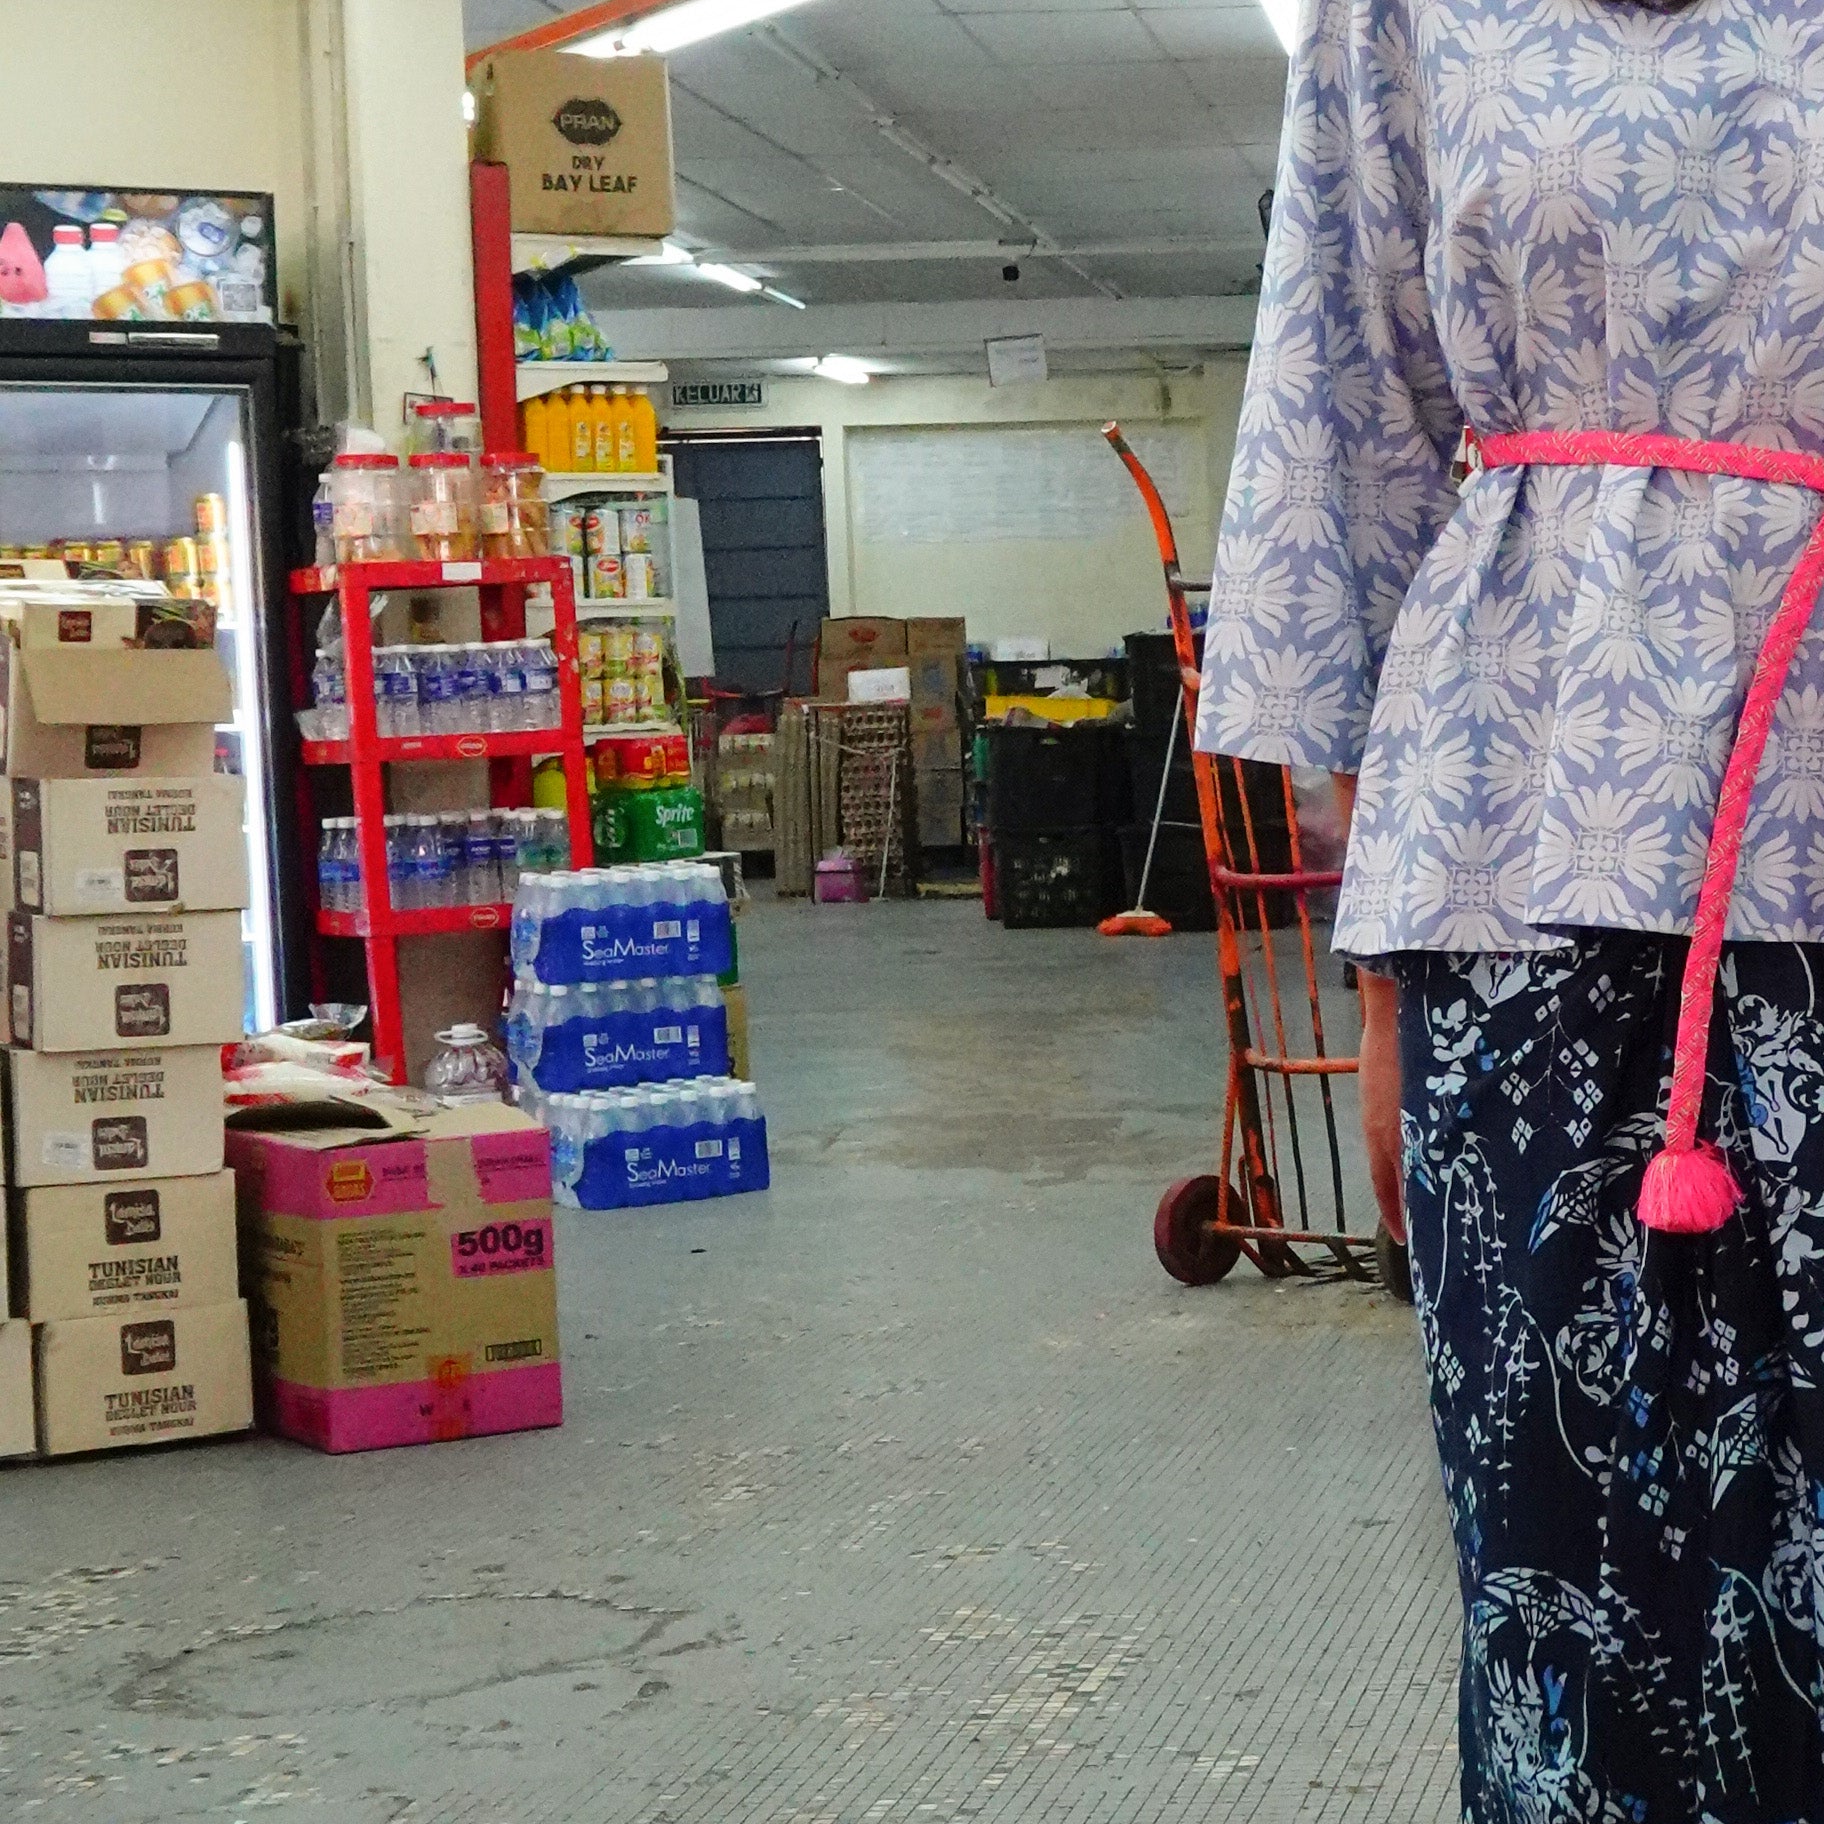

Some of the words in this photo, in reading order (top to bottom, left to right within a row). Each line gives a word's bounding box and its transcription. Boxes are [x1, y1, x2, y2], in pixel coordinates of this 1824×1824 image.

[572, 155, 605, 171] DRY
[542, 173, 582, 191] BAY
[589, 174, 637, 193] LEAF
[675, 383, 745, 404] KELUAR
[108, 815, 196, 834] TUNISIAN
[656, 804, 694, 827] Sprite
[582, 938, 668, 960] SeaMaster
[97, 951, 187, 970] TUNISIAN
[585, 1043, 670, 1067] SeaMaster
[74, 1083, 164, 1104] TUNISIAN
[627, 1158, 711, 1182] SeaMaster
[458, 1226, 544, 1256] 500g
[88, 1256, 179, 1278] TUNISIAN
[104, 1384, 194, 1409] TUNISIAN
